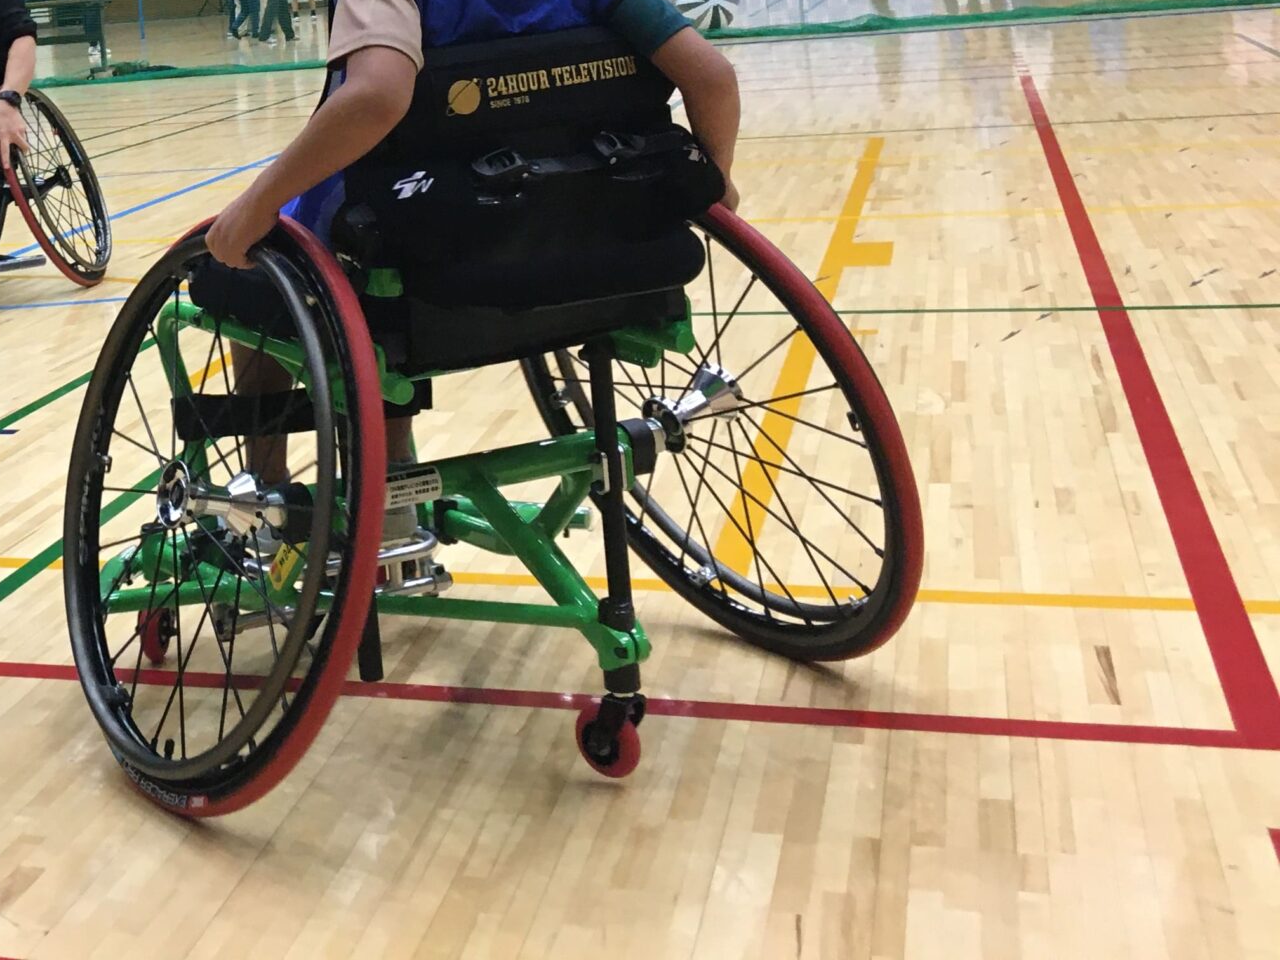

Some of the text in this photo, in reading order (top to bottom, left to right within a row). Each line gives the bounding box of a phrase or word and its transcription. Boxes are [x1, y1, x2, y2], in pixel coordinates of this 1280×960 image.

[486, 55, 638, 98] 24HOUR TELEVISION
[490, 98, 512, 109] SINCE
